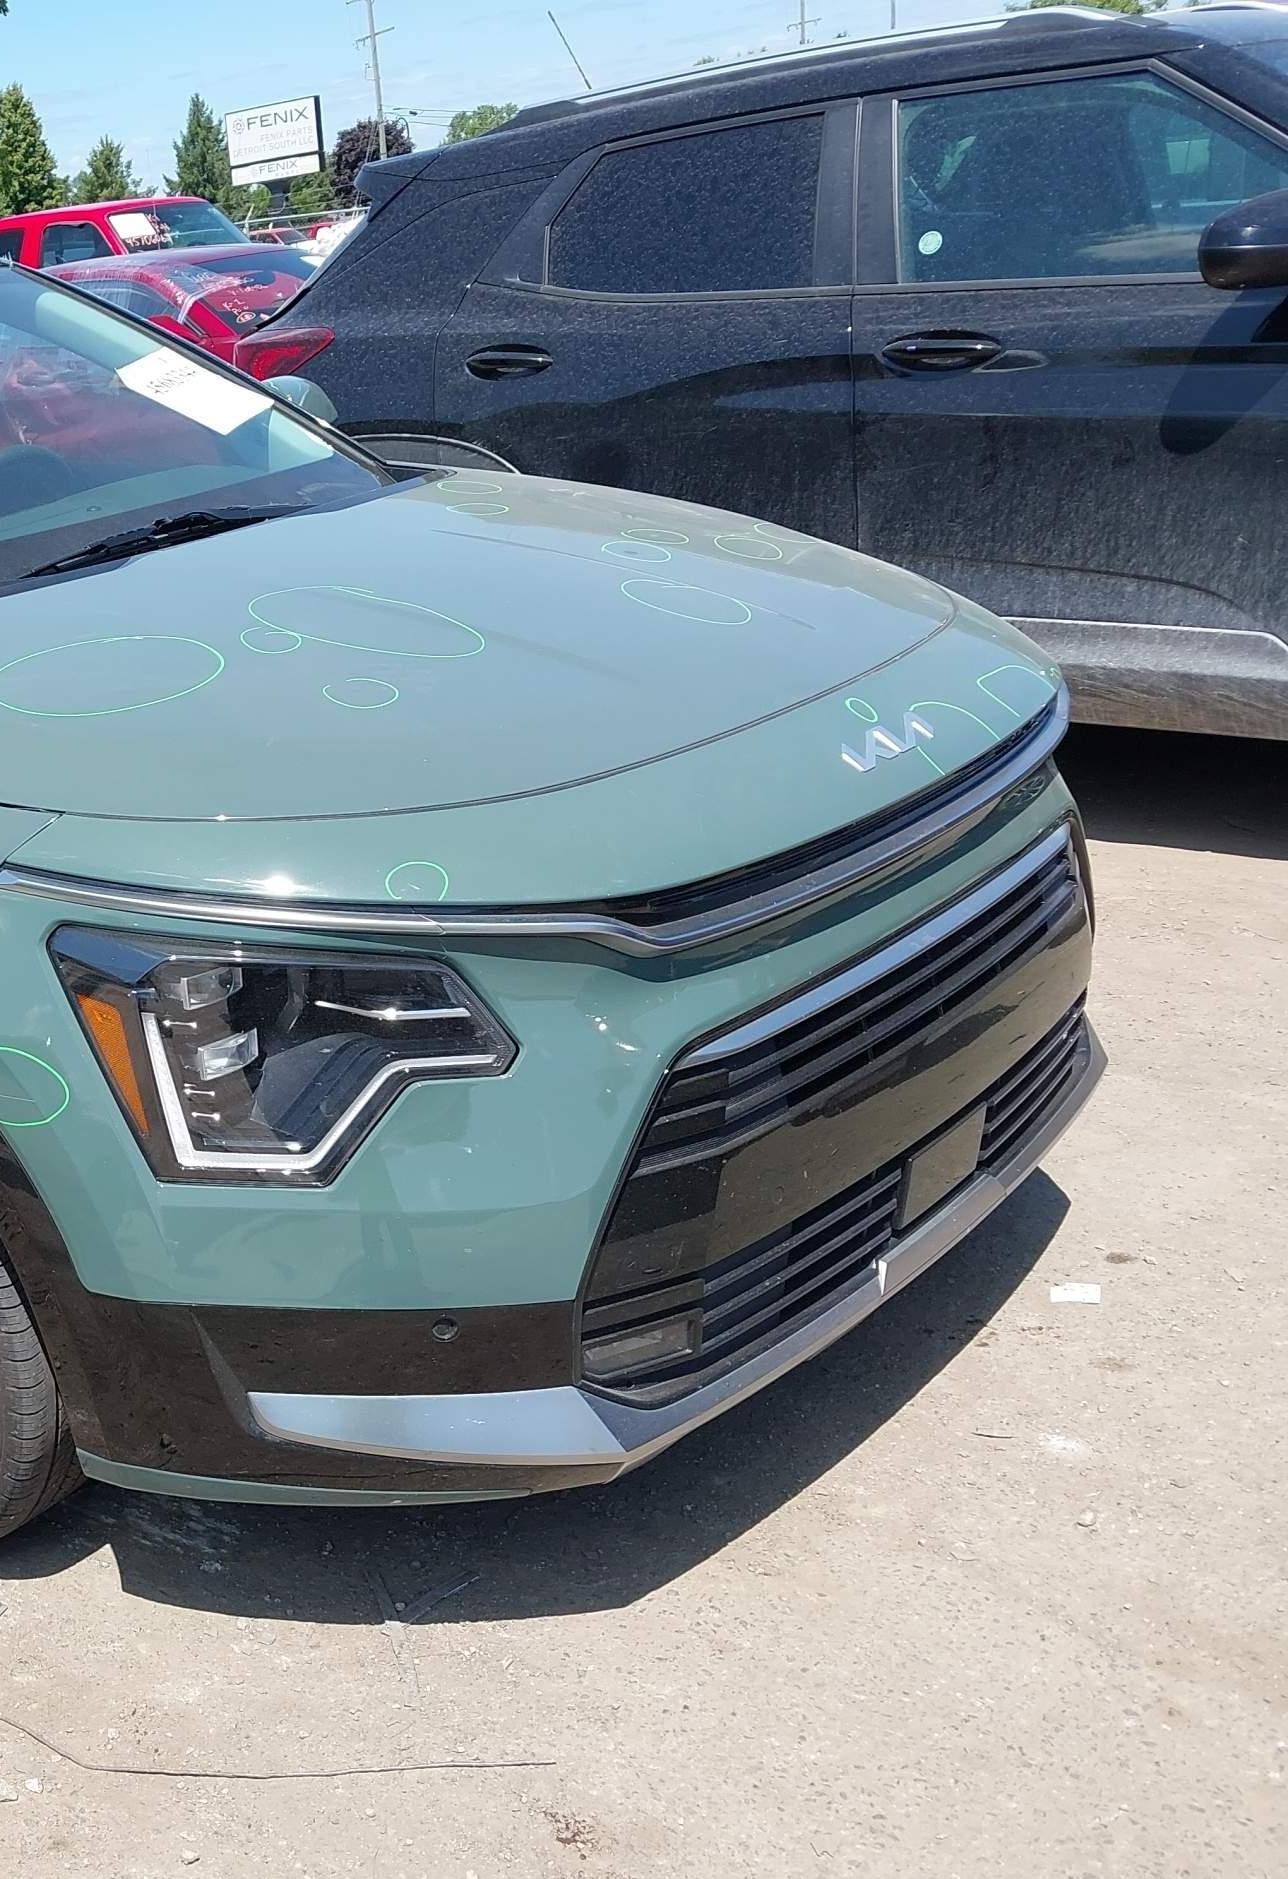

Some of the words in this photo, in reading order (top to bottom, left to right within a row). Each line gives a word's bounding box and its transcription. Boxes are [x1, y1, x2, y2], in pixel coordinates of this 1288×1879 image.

[247, 106, 309, 130] FENIX
[269, 139, 297, 152] SOUTH
[299, 135, 314, 146] LLC
[259, 160, 298, 175] FENIX
